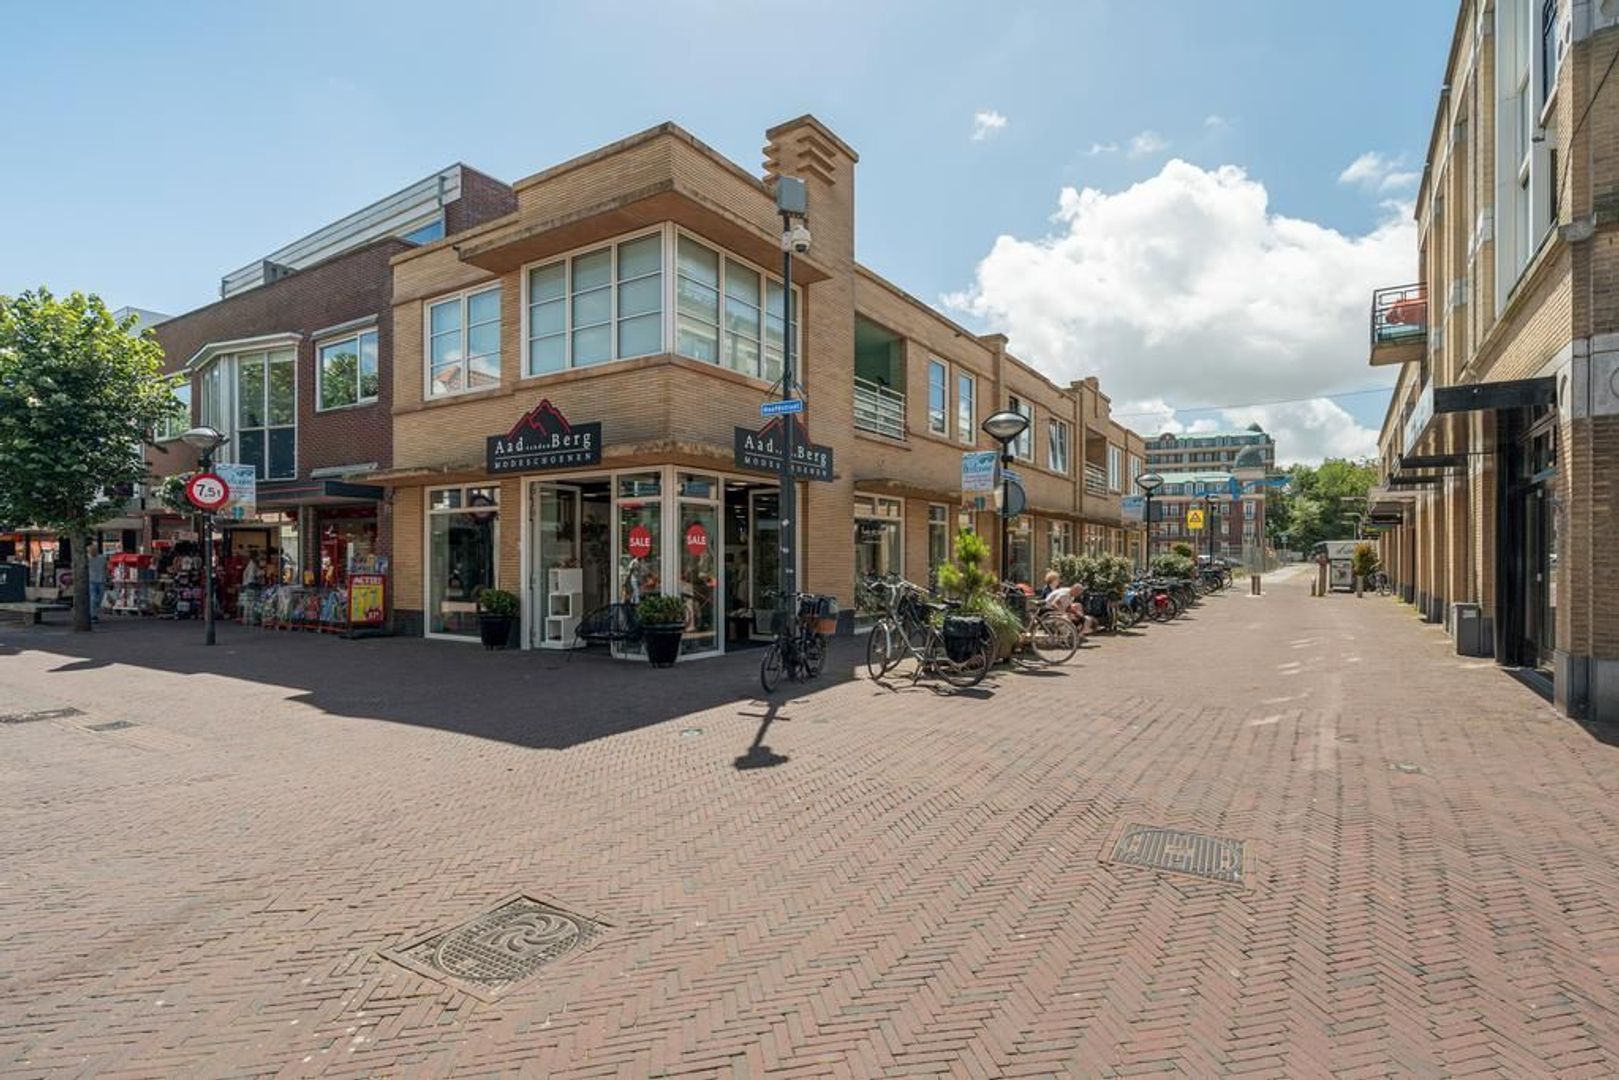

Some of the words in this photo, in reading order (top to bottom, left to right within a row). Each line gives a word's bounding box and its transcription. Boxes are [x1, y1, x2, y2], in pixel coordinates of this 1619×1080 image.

[494, 436, 524, 454] Aad
[551, 433, 591, 450] Berg
[744, 435, 773, 453] Aad
[797, 445, 827, 467] Berg
[629, 537, 651, 547] SALE
[686, 535, 707, 545] SALE
